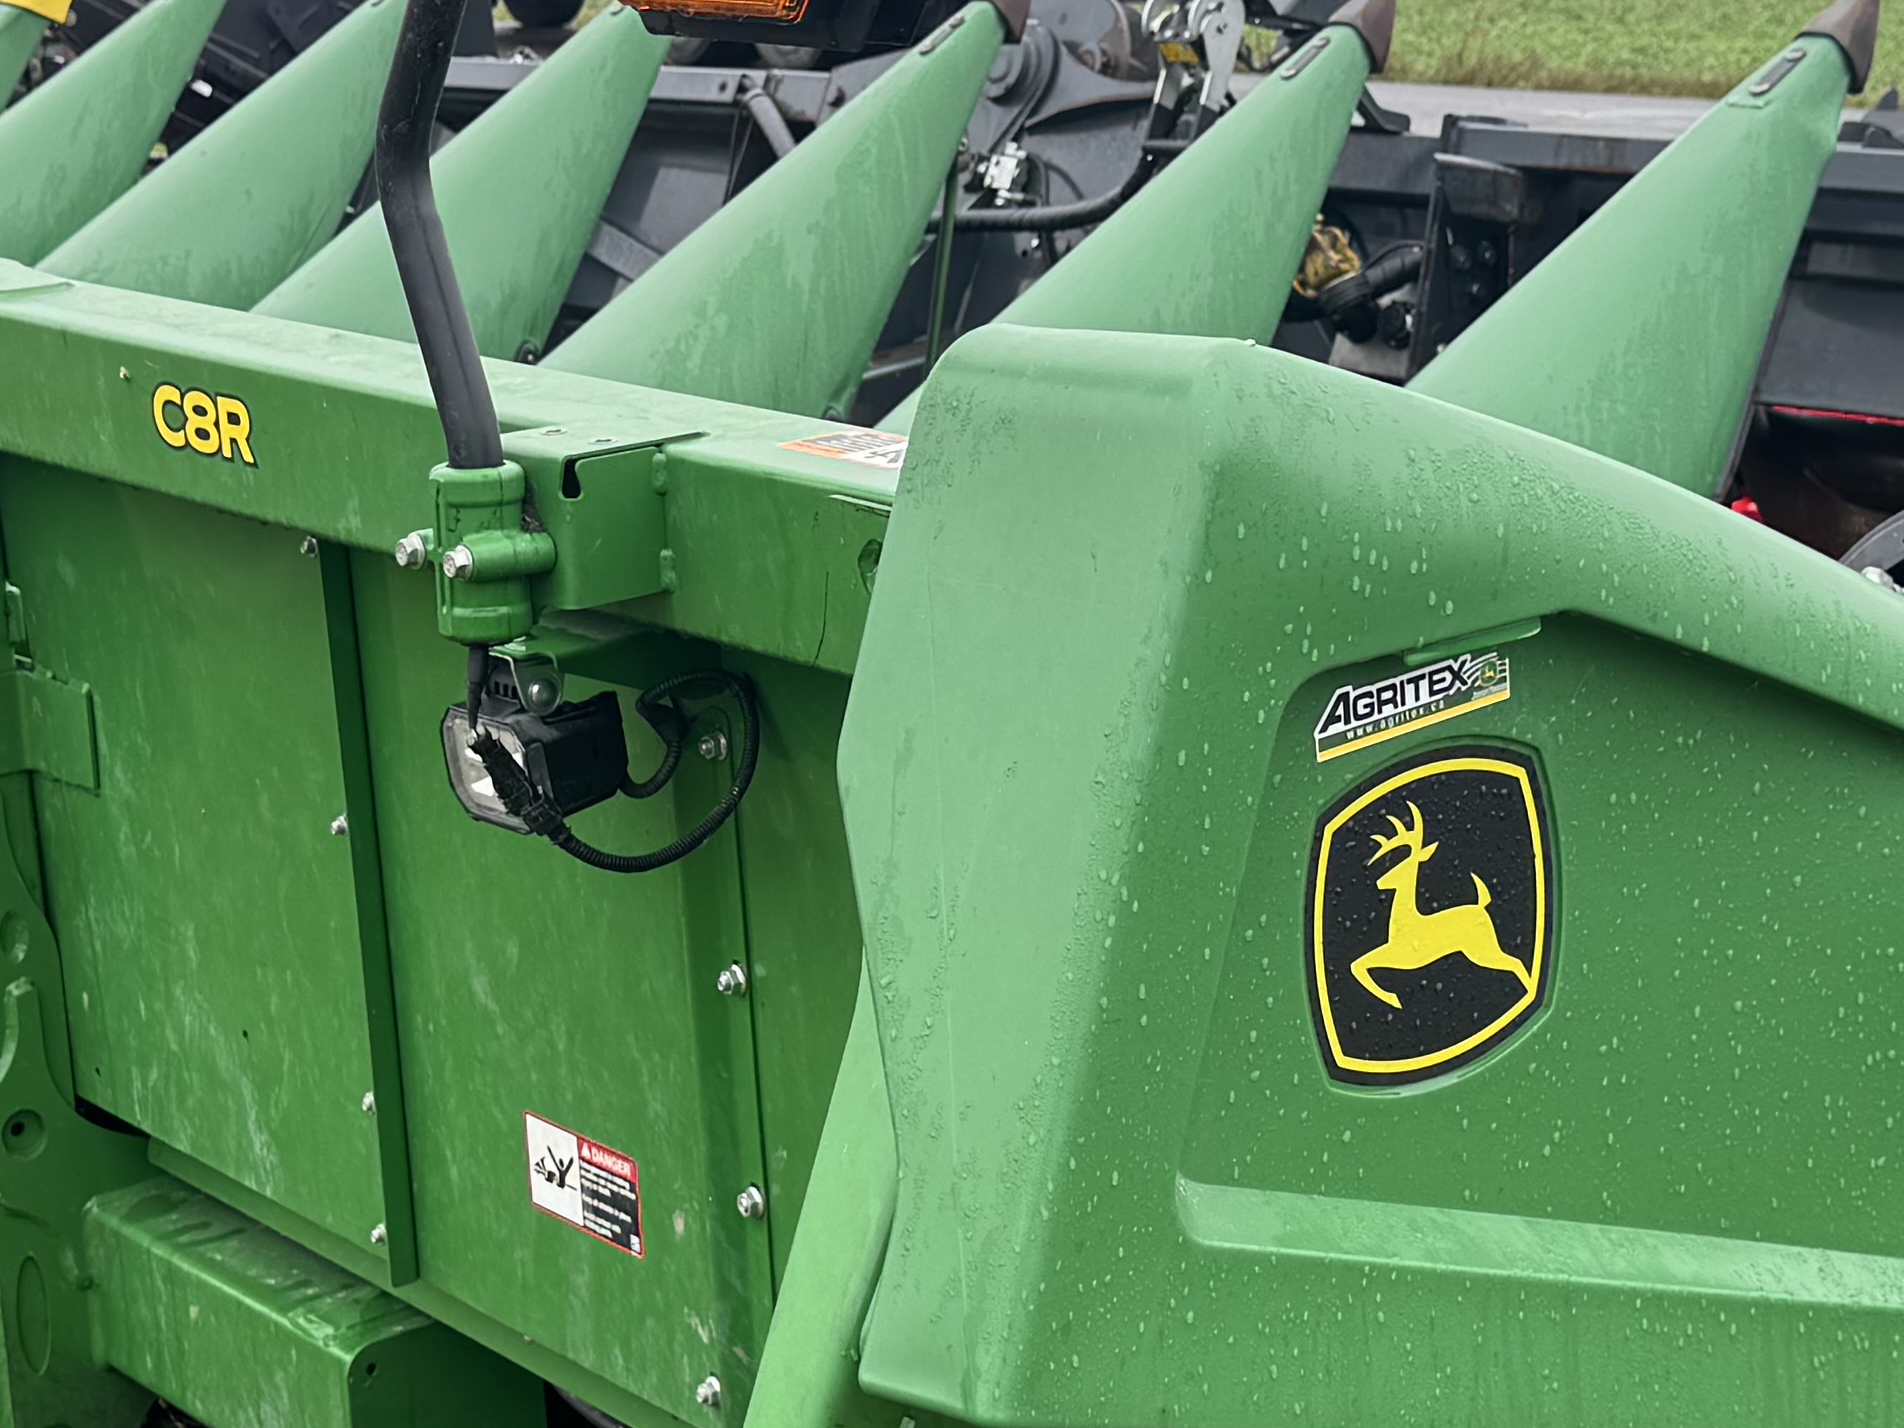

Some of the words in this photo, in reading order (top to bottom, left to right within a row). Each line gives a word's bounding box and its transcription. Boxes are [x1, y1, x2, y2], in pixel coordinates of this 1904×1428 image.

[152, 382, 258, 468] C8R
[1319, 658, 1469, 734] AGRITEX
[590, 1145, 631, 1178] DANGER
